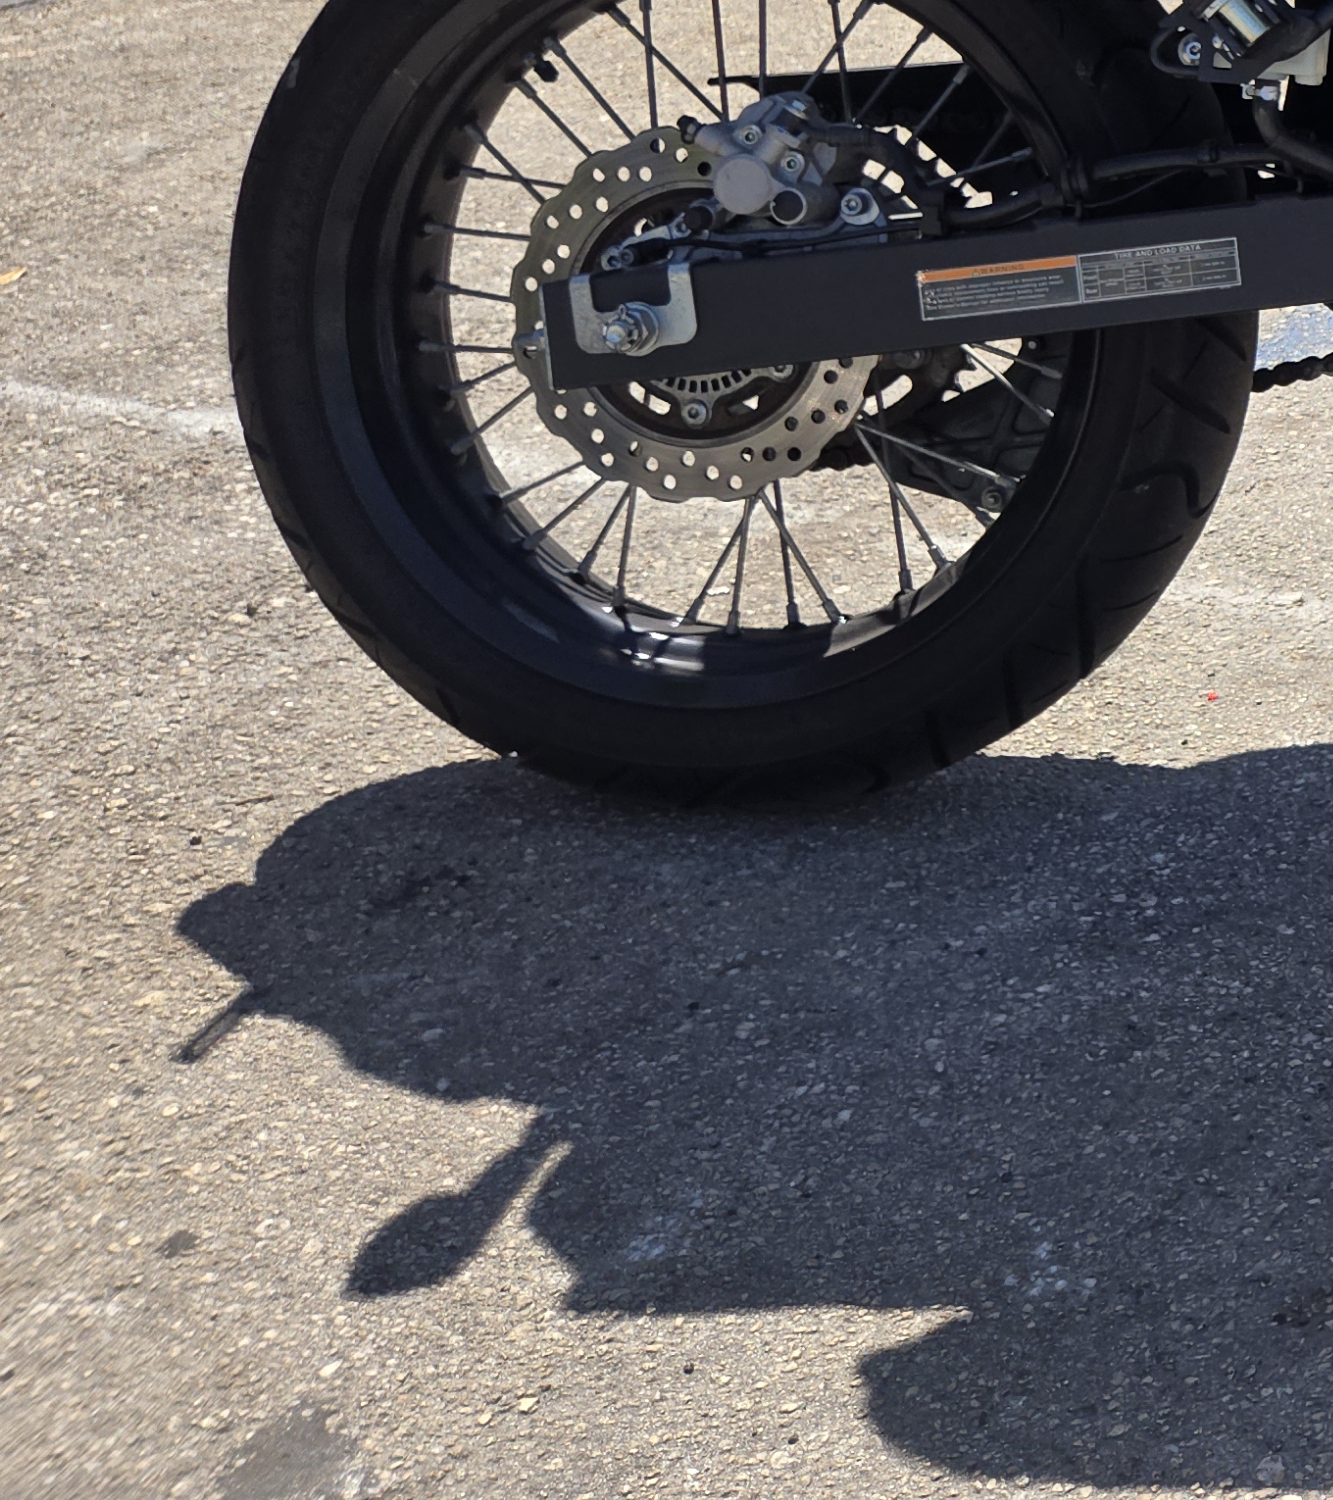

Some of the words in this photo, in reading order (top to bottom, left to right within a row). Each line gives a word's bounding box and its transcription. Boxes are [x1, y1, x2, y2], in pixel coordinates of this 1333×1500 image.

[1135, 249, 1153, 258] AND
[1154, 246, 1178, 256] LOAD
[1179, 244, 1202, 253] DATA
[979, 263, 1025, 275] WARNING
